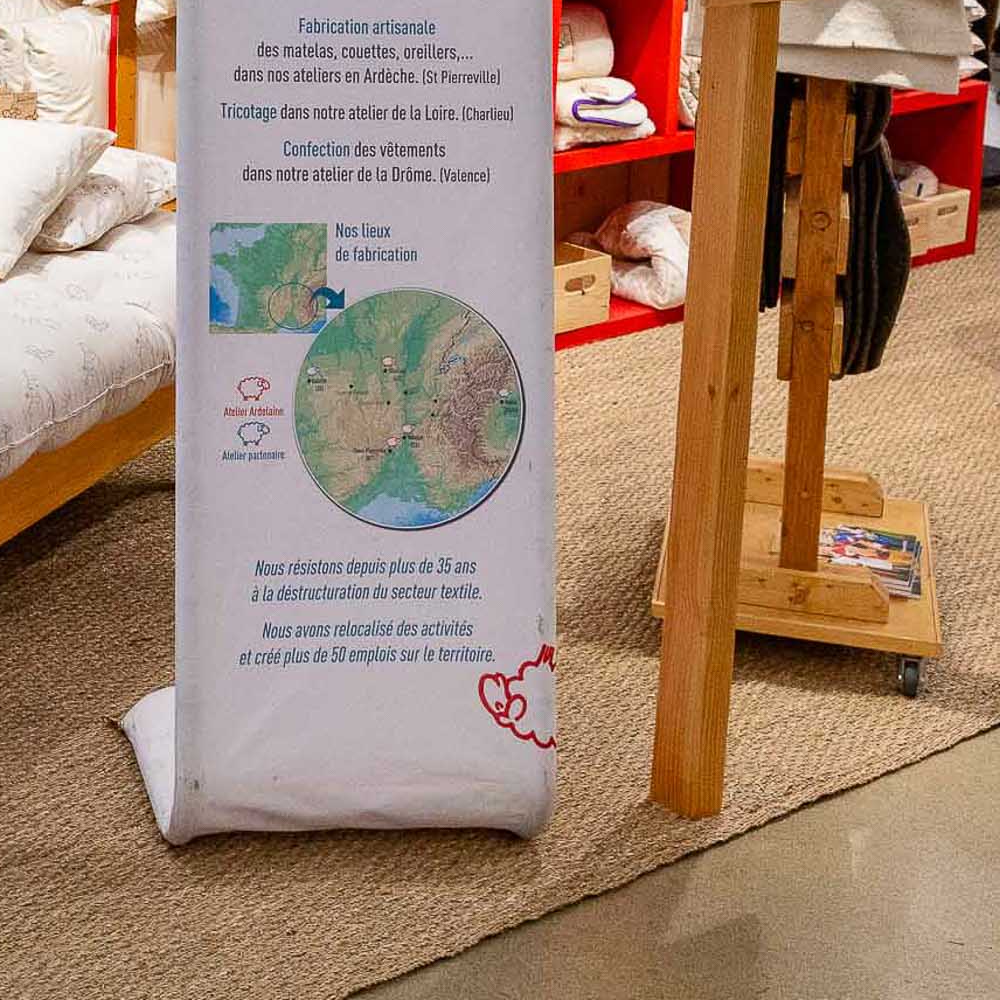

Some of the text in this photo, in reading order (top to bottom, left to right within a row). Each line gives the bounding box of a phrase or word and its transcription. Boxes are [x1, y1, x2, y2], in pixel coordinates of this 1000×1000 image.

[299, 17, 436, 35] Fabrication artisanale
[257, 41, 473, 62] des matelas, couettes, oreillers,...
[234, 65, 263, 82] dans
[267, 70, 292, 83] nos
[293, 66, 341, 83] ateliers
[345, 71, 360, 84] en
[363, 67, 419, 84] Ardèche.
[220, 102, 277, 123] Tricotage
[280, 103, 310, 120] dans
[313, 105, 345, 120] notre
[348, 104, 389, 120] atelier
[392, 104, 407, 121] de
[410, 104, 421, 121] la
[425, 104, 459, 121] Loire.
[283, 140, 446, 158] Confection des vêtements
[242, 164, 272, 182] dans
[276, 166, 309, 182] notre
[312, 166, 354, 183] atelier
[357, 166, 372, 182] de
[376, 166, 387, 182] la
[392, 166, 436, 182] Drôme.
[336, 222, 391, 238] Nos lieux
[335, 246, 417, 262] de fabrication
[254, 557, 477, 578] Nous résistons depuis plus de 35 ans
[251, 582, 482, 602] à la déstructuration du secteur textile.
[262, 619, 474, 639] Nous avons relocalisé des activités
[239, 645, 495, 668] et créé plus de 50 emplois sur le territoire.
